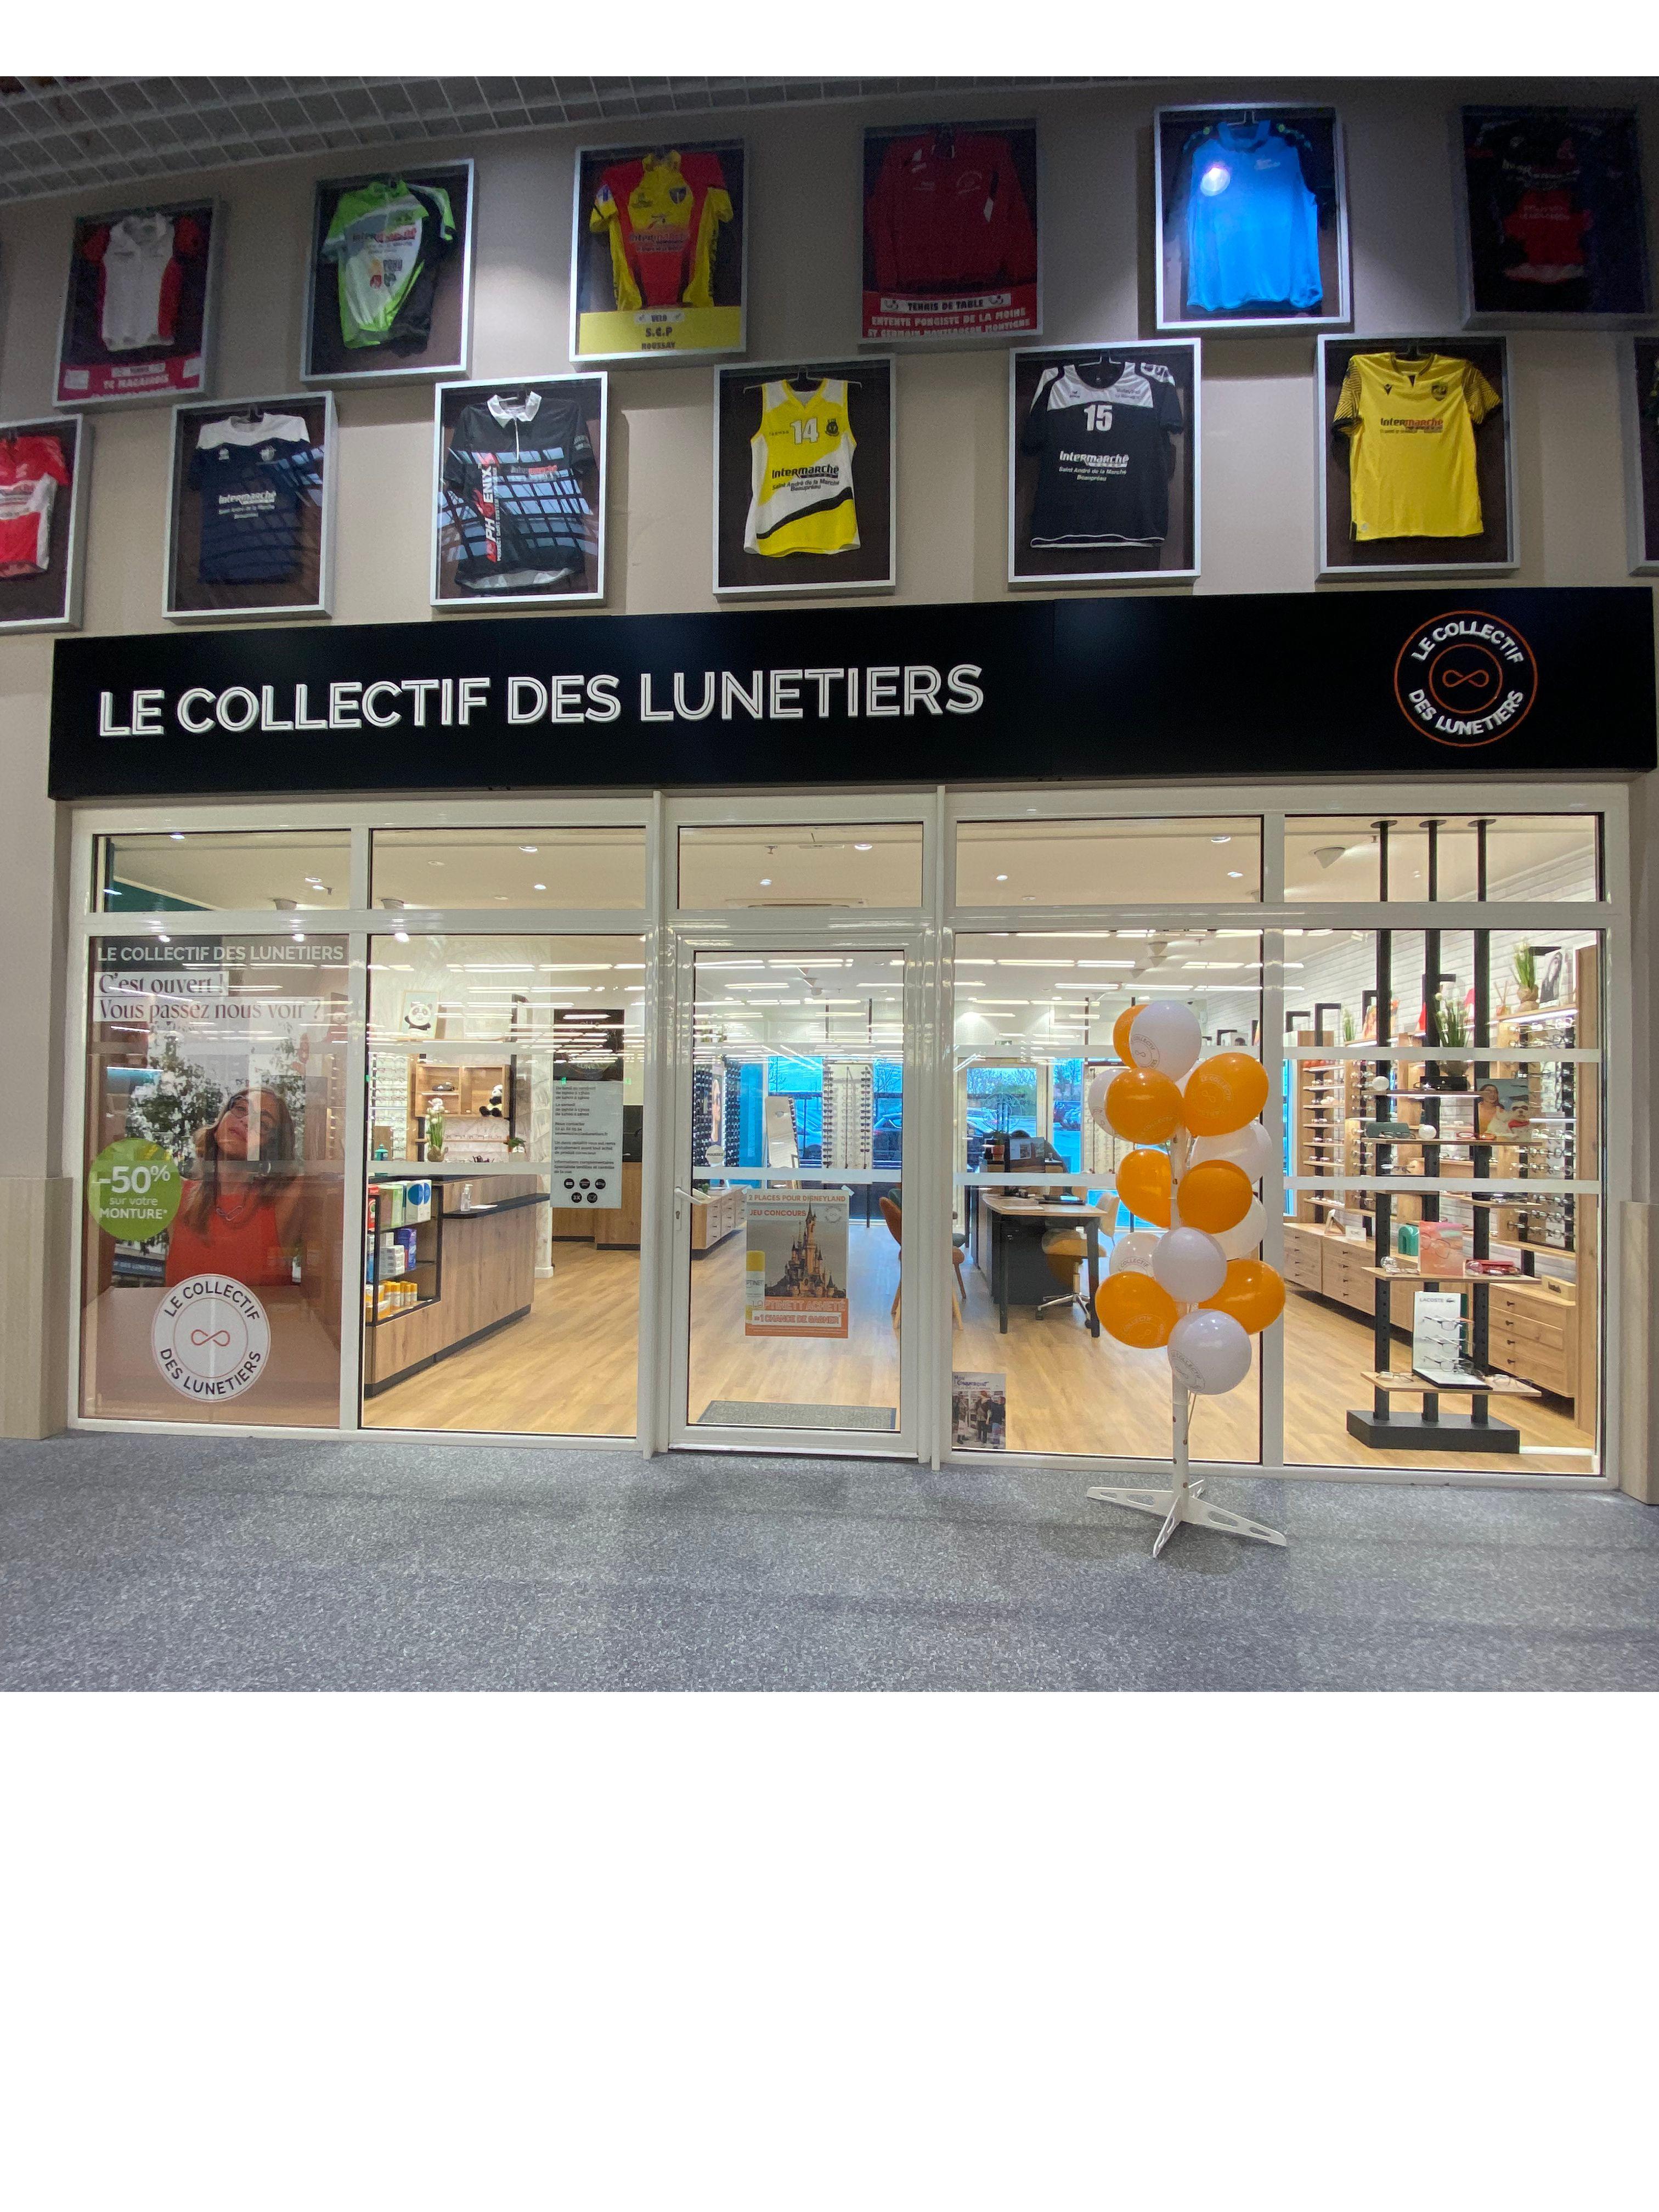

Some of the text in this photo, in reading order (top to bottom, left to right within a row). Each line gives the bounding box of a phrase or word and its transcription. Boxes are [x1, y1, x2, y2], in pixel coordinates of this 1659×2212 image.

[942, 301, 953, 310] DE
[1084, 404, 1113, 431] 15
[790, 417, 820, 445] 14
[772, 464, 839, 478] Intermarché
[1059, 451, 1130, 467] Intermarché
[1410, 620, 1524, 663] LE COLLECTIF
[99, 664, 984, 737] LE COLLECTIF DES LUNETIERS
[1408, 689, 1523, 735] DES LUNETIERS
[98, 945, 344, 962] LE COLLECTIF DES LUNETIERS
[99, 973, 144, 995] C'est
[151, 977, 213, 994] ouvert
[99, 998, 144, 1019] Vous
[149, 1001, 210, 1024] passez
[215, 1002, 261, 1019] nous
[268, 1000, 306, 1019] voir
[98, 1165, 171, 1194] -50%
[109, 1197, 159, 1206] sur votre
[164, 1281, 261, 1320] LE COLLECTIF
[765, 1314, 795, 1323] CHANCE
[797, 1315, 807, 1323] DE
[160, 1347, 261, 1395] DES LUNETIERS
